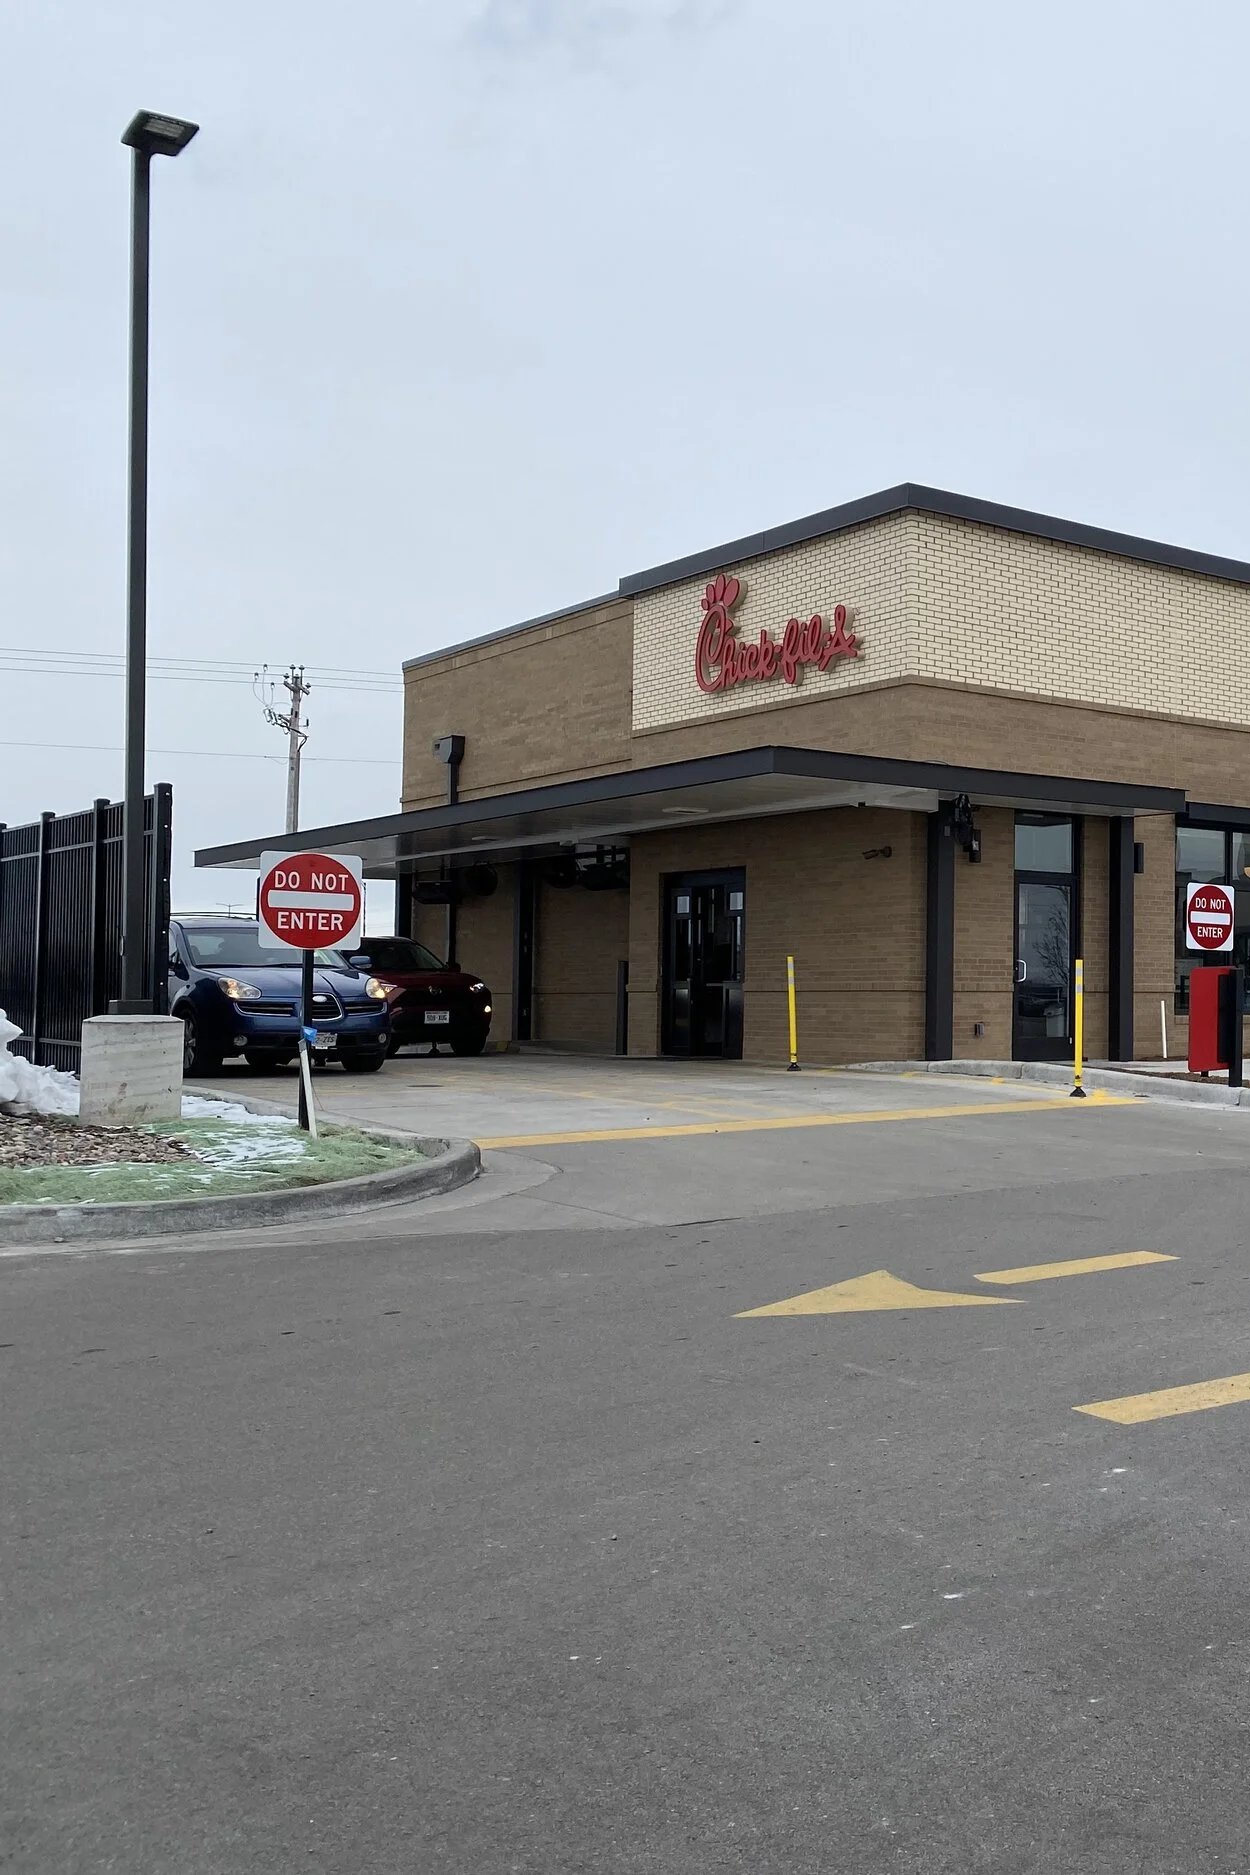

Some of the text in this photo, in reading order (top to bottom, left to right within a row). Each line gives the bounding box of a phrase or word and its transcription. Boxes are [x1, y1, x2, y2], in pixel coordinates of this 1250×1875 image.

[695, 574, 858, 692] Chick-fil-A
[274, 870, 349, 891] DO NOT
[1195, 897, 1226, 910] DO NOT
[277, 911, 344, 931] ENTER
[1197, 926, 1223, 938] ENTER
